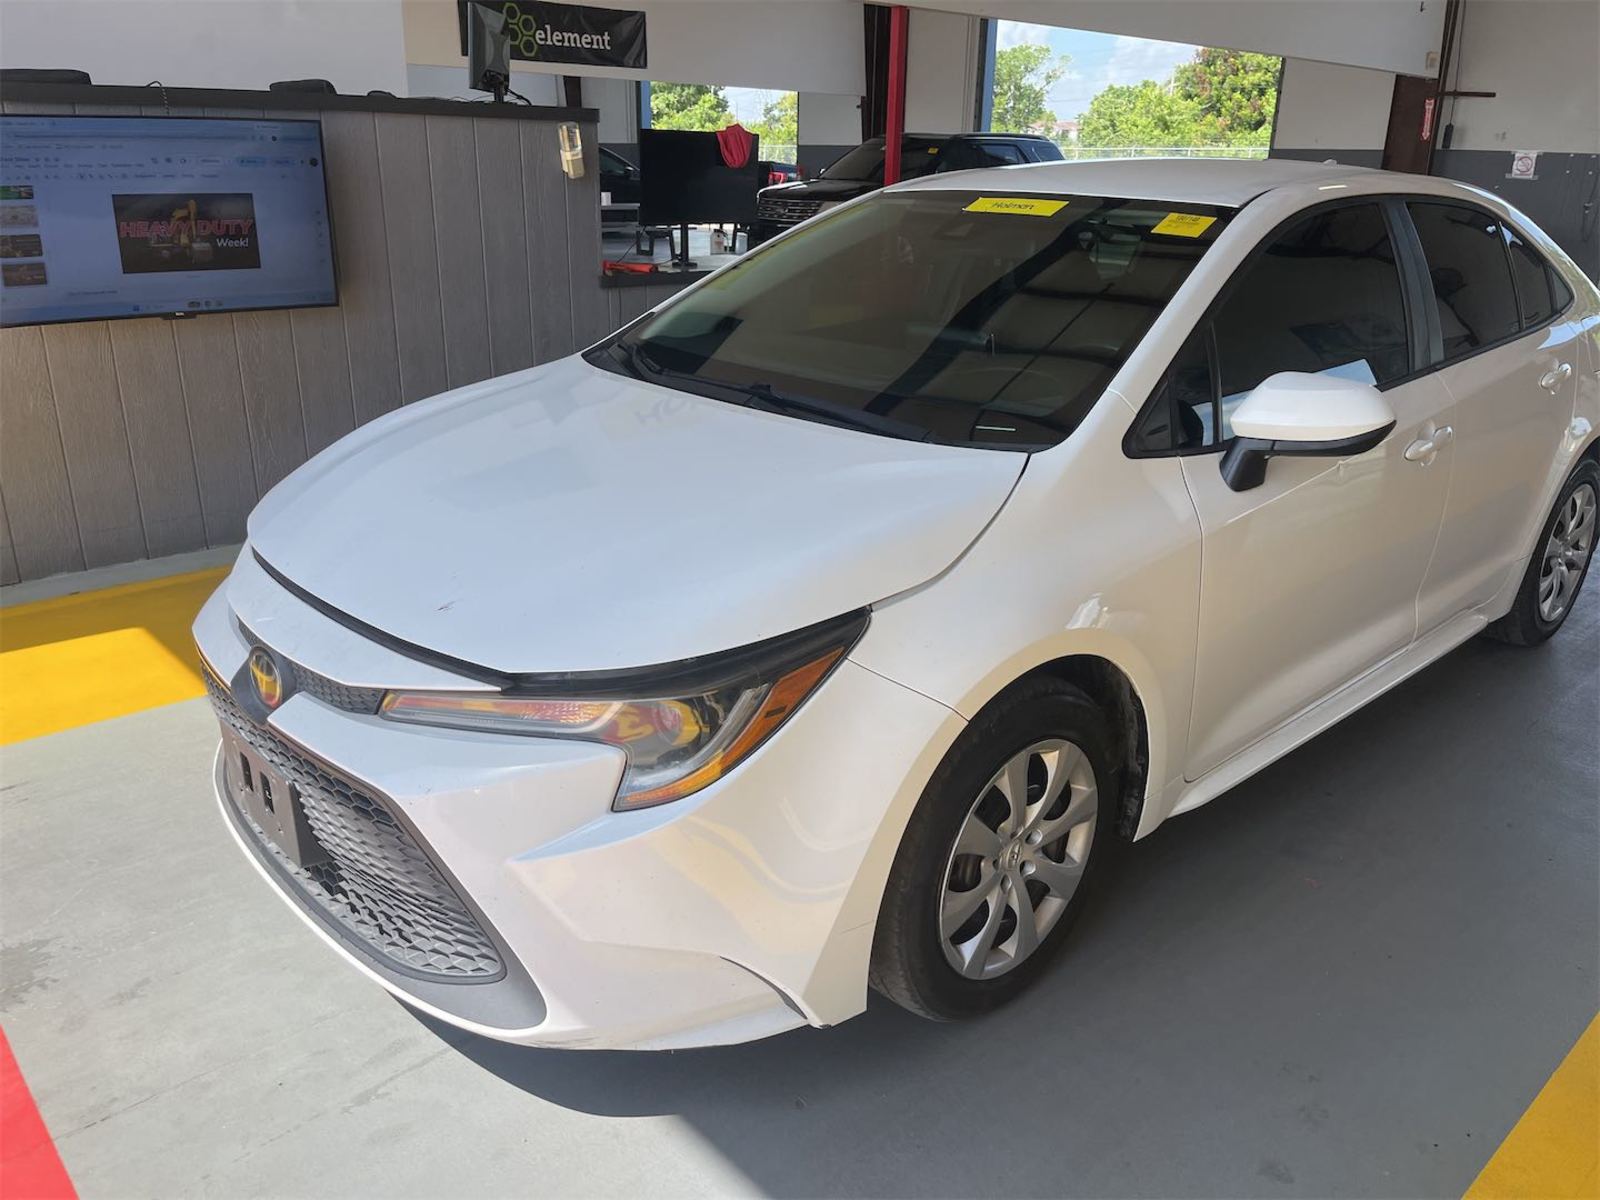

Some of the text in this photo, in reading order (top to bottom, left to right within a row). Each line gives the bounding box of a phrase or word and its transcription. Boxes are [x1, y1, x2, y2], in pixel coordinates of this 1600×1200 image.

[535, 25, 611, 50] element
[119, 219, 252, 238] HEAVY DUTY
[216, 238, 249, 248] Week!
